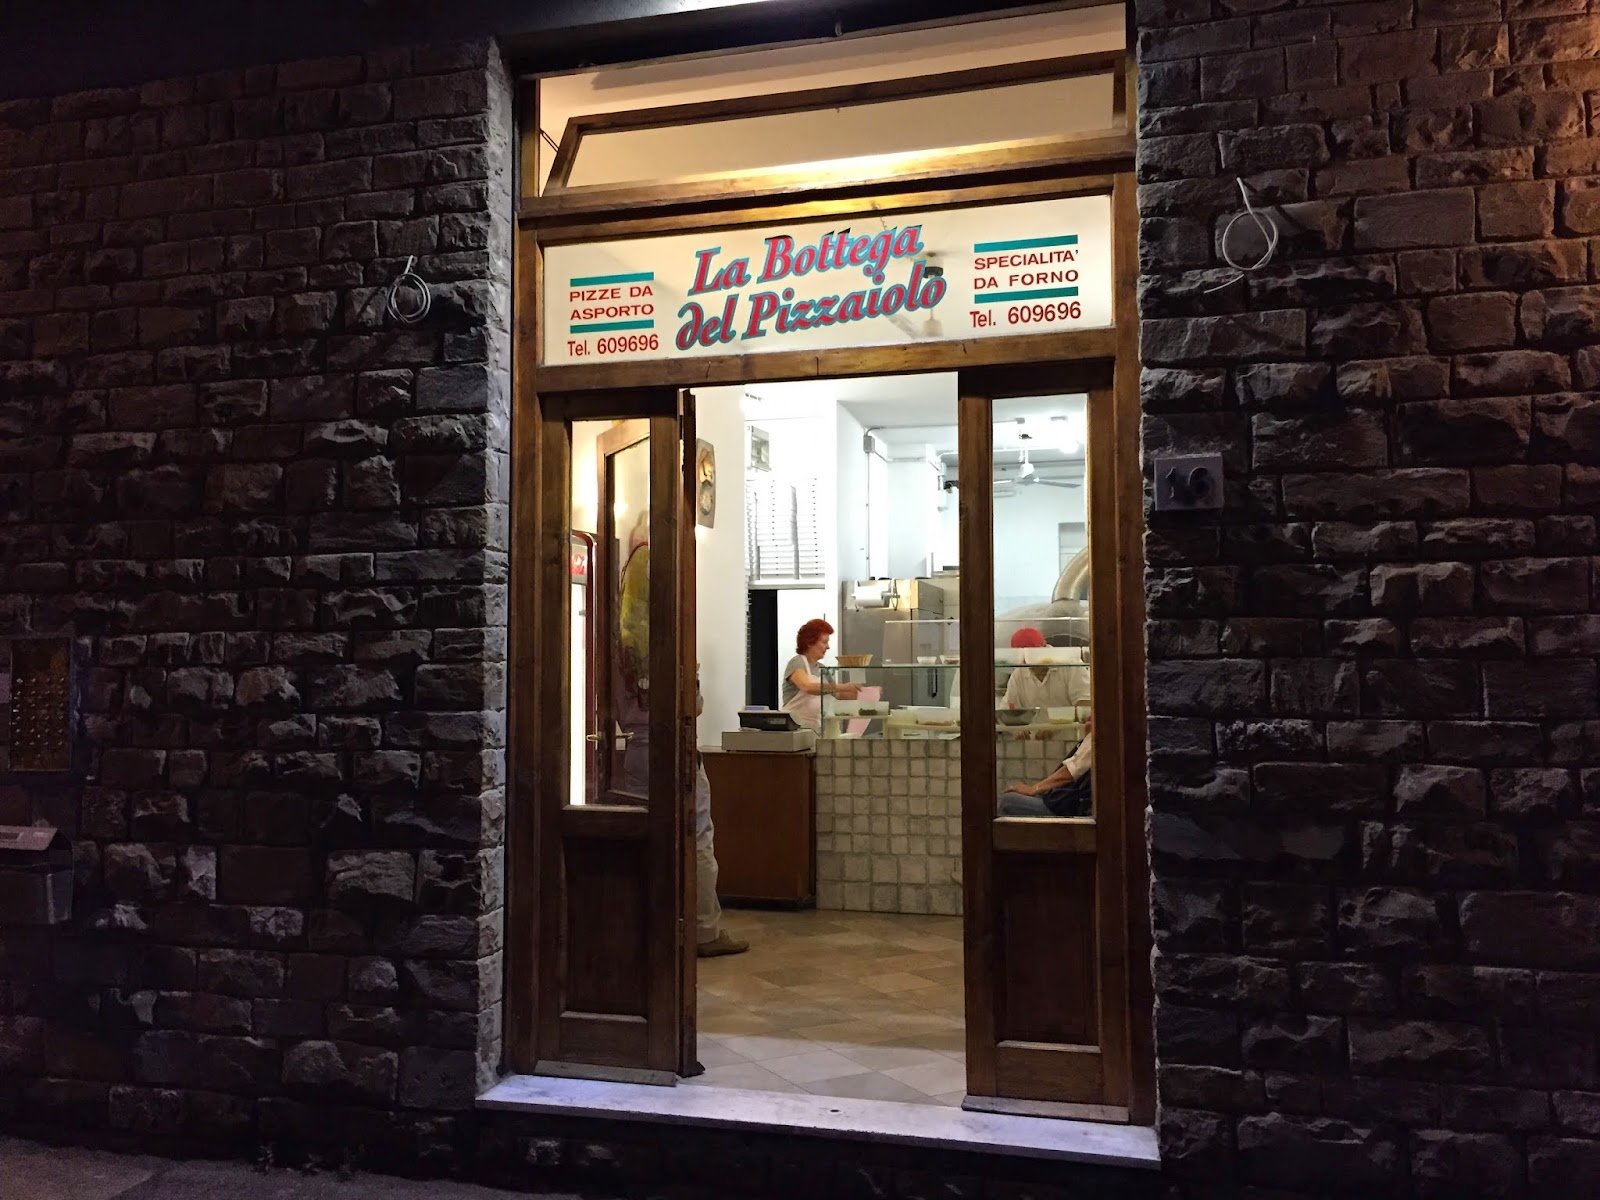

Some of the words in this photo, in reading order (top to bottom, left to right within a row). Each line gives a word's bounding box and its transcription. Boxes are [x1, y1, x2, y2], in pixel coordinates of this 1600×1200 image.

[688, 246, 751, 296] La
[756, 224, 924, 284] Bottega
[974, 249, 1079, 270] SPECIALITA'
[974, 277, 998, 290] DA
[1009, 269, 1079, 286] FORNO
[569, 287, 621, 302] PIZZE
[630, 285, 653, 298] DA
[675, 293, 738, 350] del
[741, 259, 947, 340] Pizzaiolo
[570, 303, 654, 320] ASPORTO
[970, 310, 996, 328] Tel.
[1008, 301, 1081, 324] 609696
[568, 339, 591, 357] Tel.
[597, 334, 659, 354] 609696
